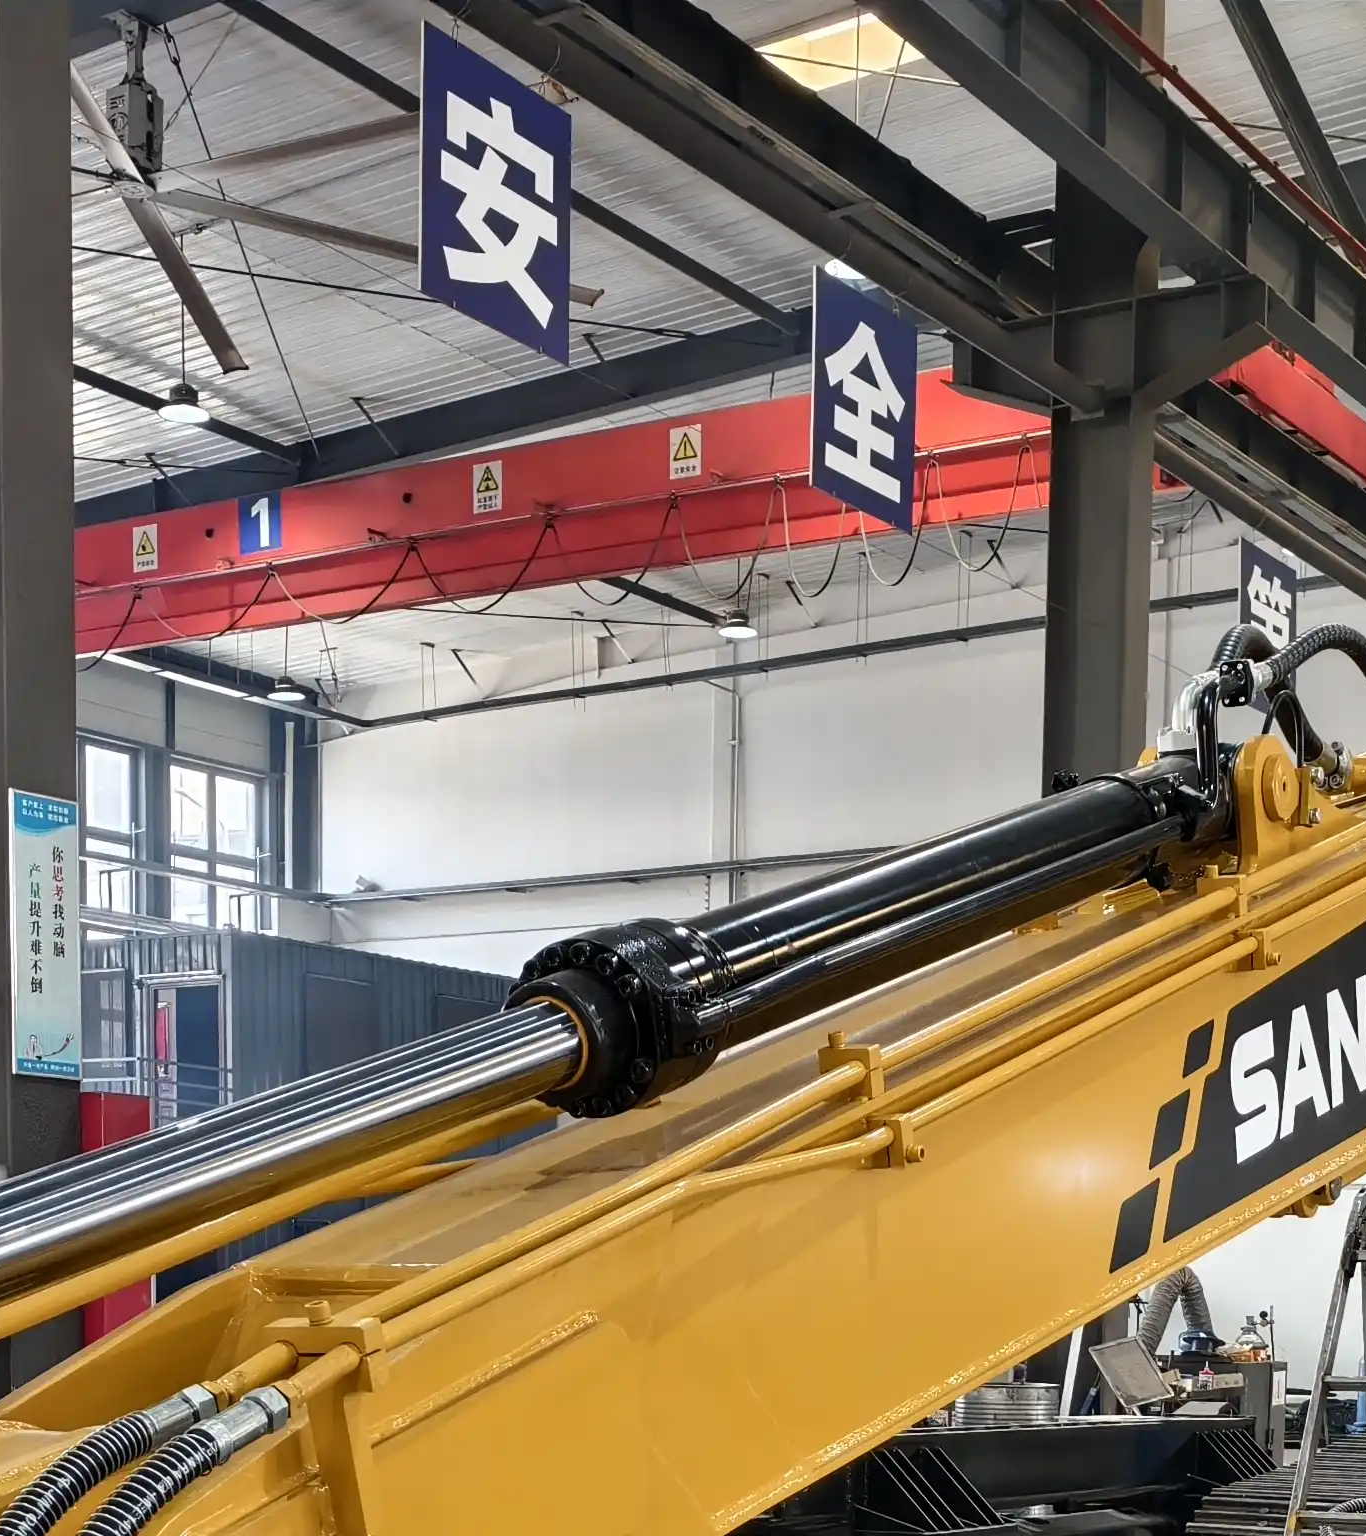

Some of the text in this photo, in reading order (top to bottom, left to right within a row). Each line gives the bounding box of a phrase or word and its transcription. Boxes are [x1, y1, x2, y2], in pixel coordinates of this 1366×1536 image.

[440, 90, 558, 330] 安
[824, 321, 906, 504] 全
[250, 497, 270, 548] 1
[28, 862, 43, 994] 产量提升难不倒
[51, 845, 66, 959] 你思考我动脑
